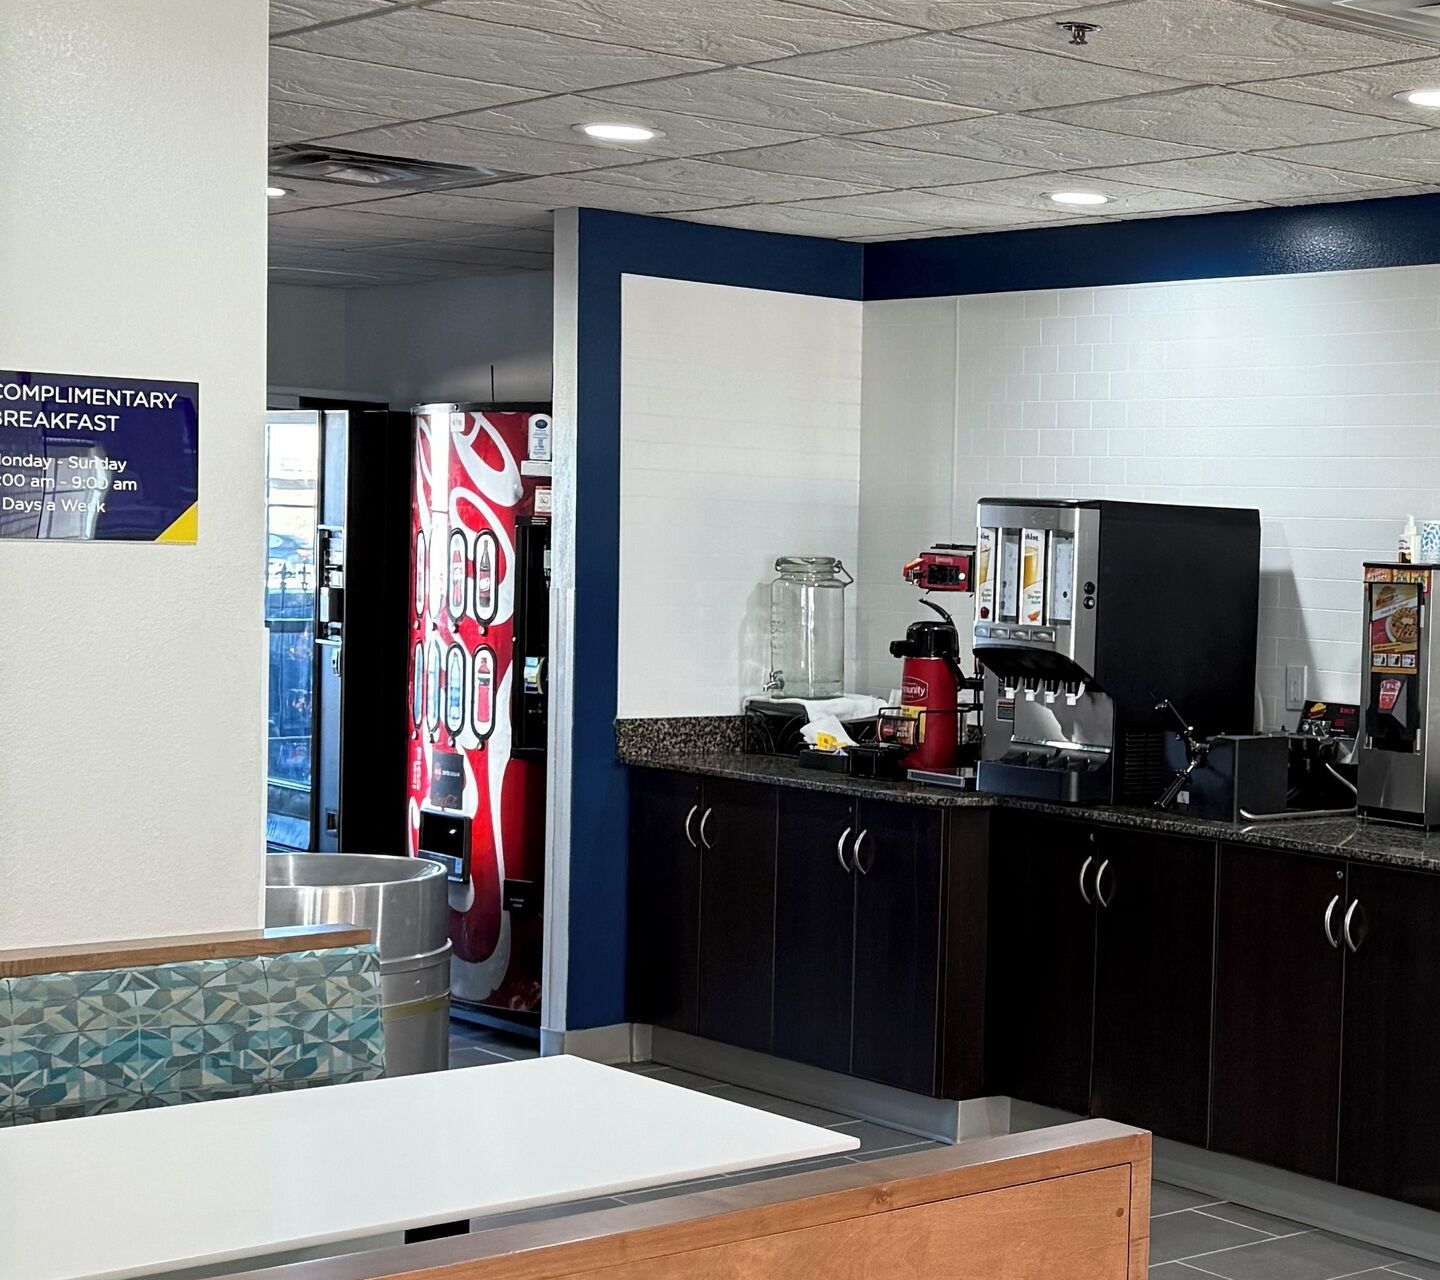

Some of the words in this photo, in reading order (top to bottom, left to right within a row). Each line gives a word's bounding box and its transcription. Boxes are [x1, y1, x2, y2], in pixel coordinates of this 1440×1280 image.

[0, 383, 178, 409] OMPLIMENTARY
[0, 454, 52, 471] onday
[68, 455, 127, 473] Sunday
[0, 473, 26, 488] :00
[30, 477, 55, 489] am
[71, 476, 109, 490] 9:00
[112, 479, 138, 491] am
[2, 496, 42, 513] Days
[46, 500, 56, 511] a
